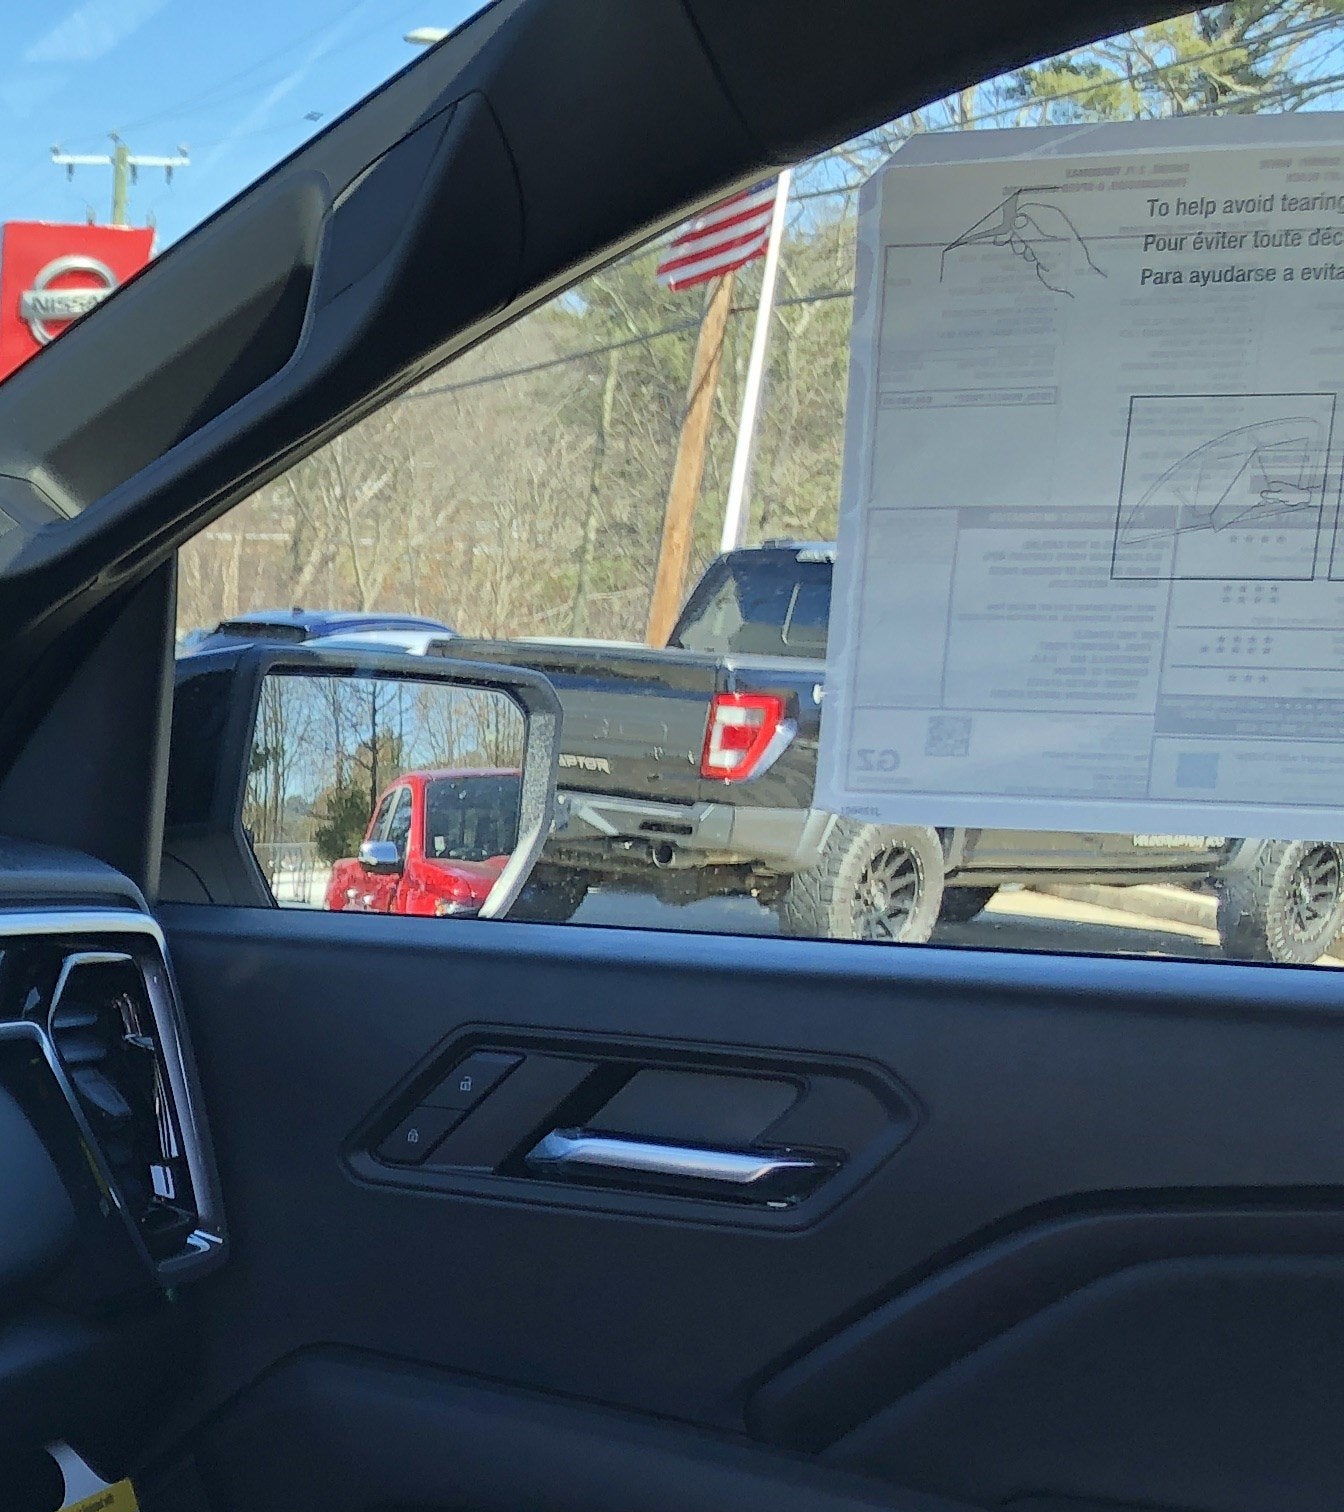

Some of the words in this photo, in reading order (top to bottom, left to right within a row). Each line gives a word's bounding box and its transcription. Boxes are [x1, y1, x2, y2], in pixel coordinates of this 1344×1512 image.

[1146, 198, 1169, 217] To
[1176, 197, 1216, 221] help
[1222, 195, 1274, 216] avoid
[1143, 233, 1183, 253] Pour
[1192, 229, 1247, 251] éviter
[1252, 229, 1303, 250] toute
[1140, 266, 1182, 286] Para
[1189, 263, 1276, 287] ayudarse
[1283, 267, 1294, 282] a
